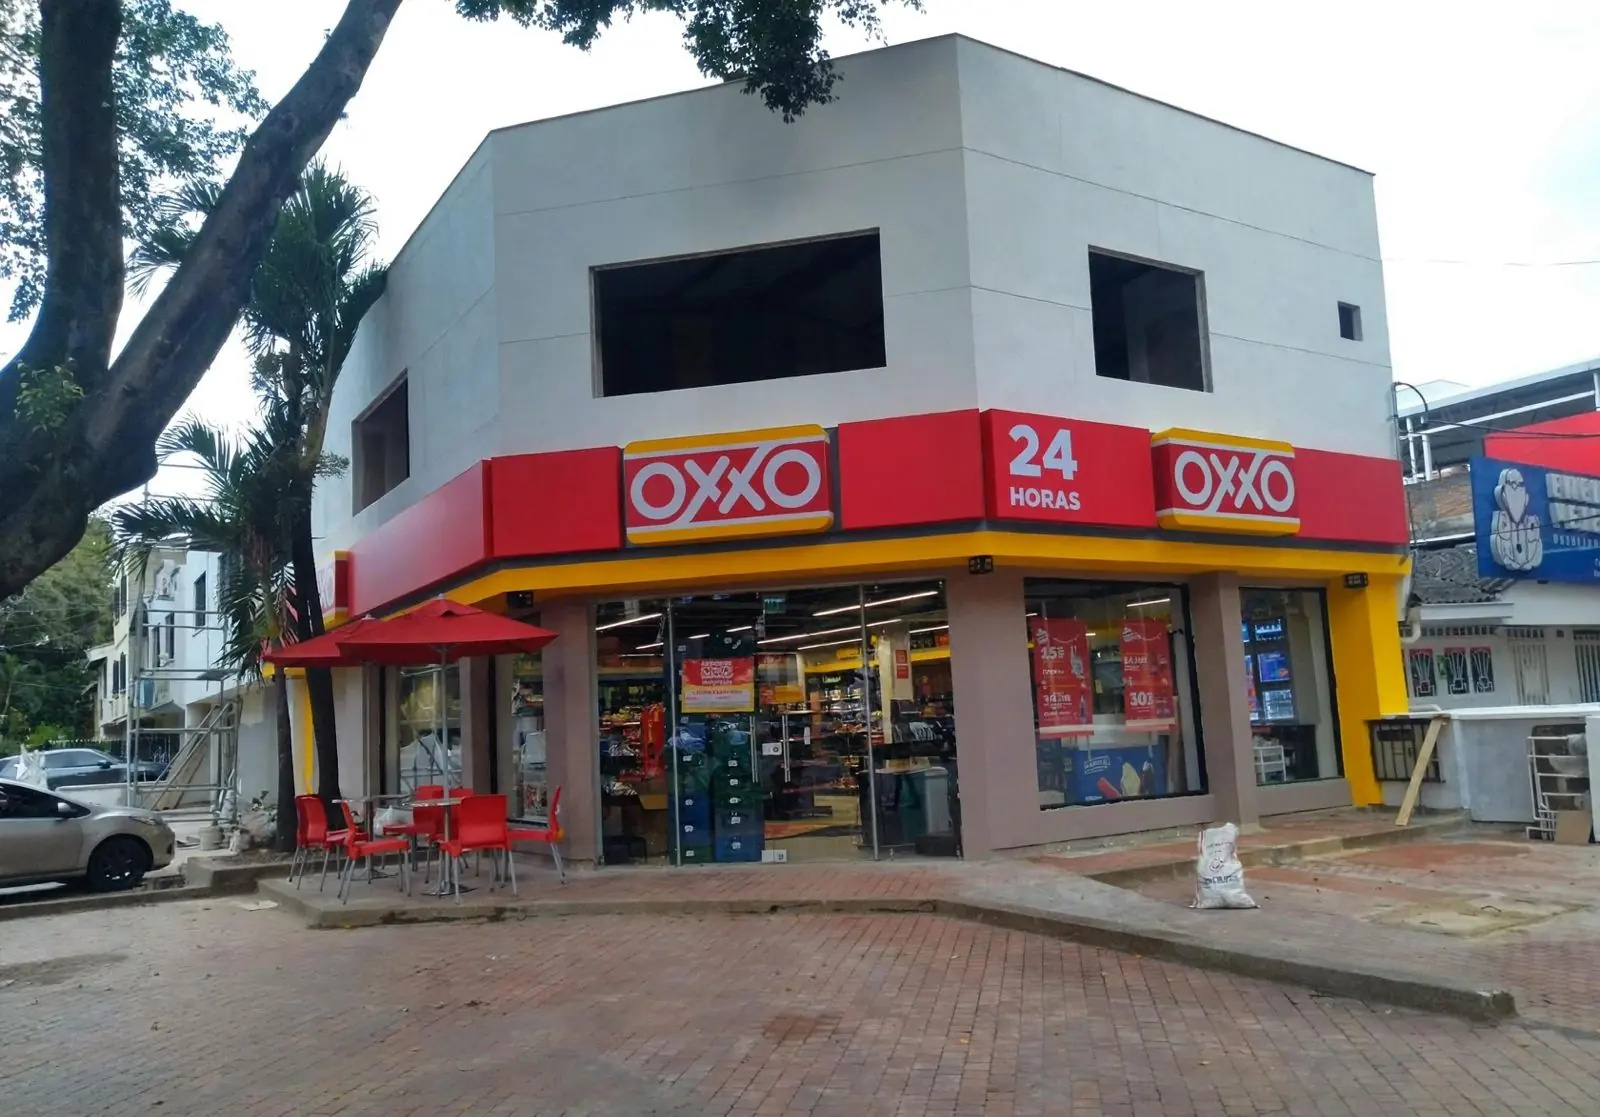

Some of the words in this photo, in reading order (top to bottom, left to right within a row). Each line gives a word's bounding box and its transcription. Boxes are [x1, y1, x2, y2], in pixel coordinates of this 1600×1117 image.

[1009, 424, 1078, 481] 24
[1174, 450, 1295, 514] OXXO
[630, 446, 821, 525] OXXO
[1009, 487, 1081, 510] HORAS
